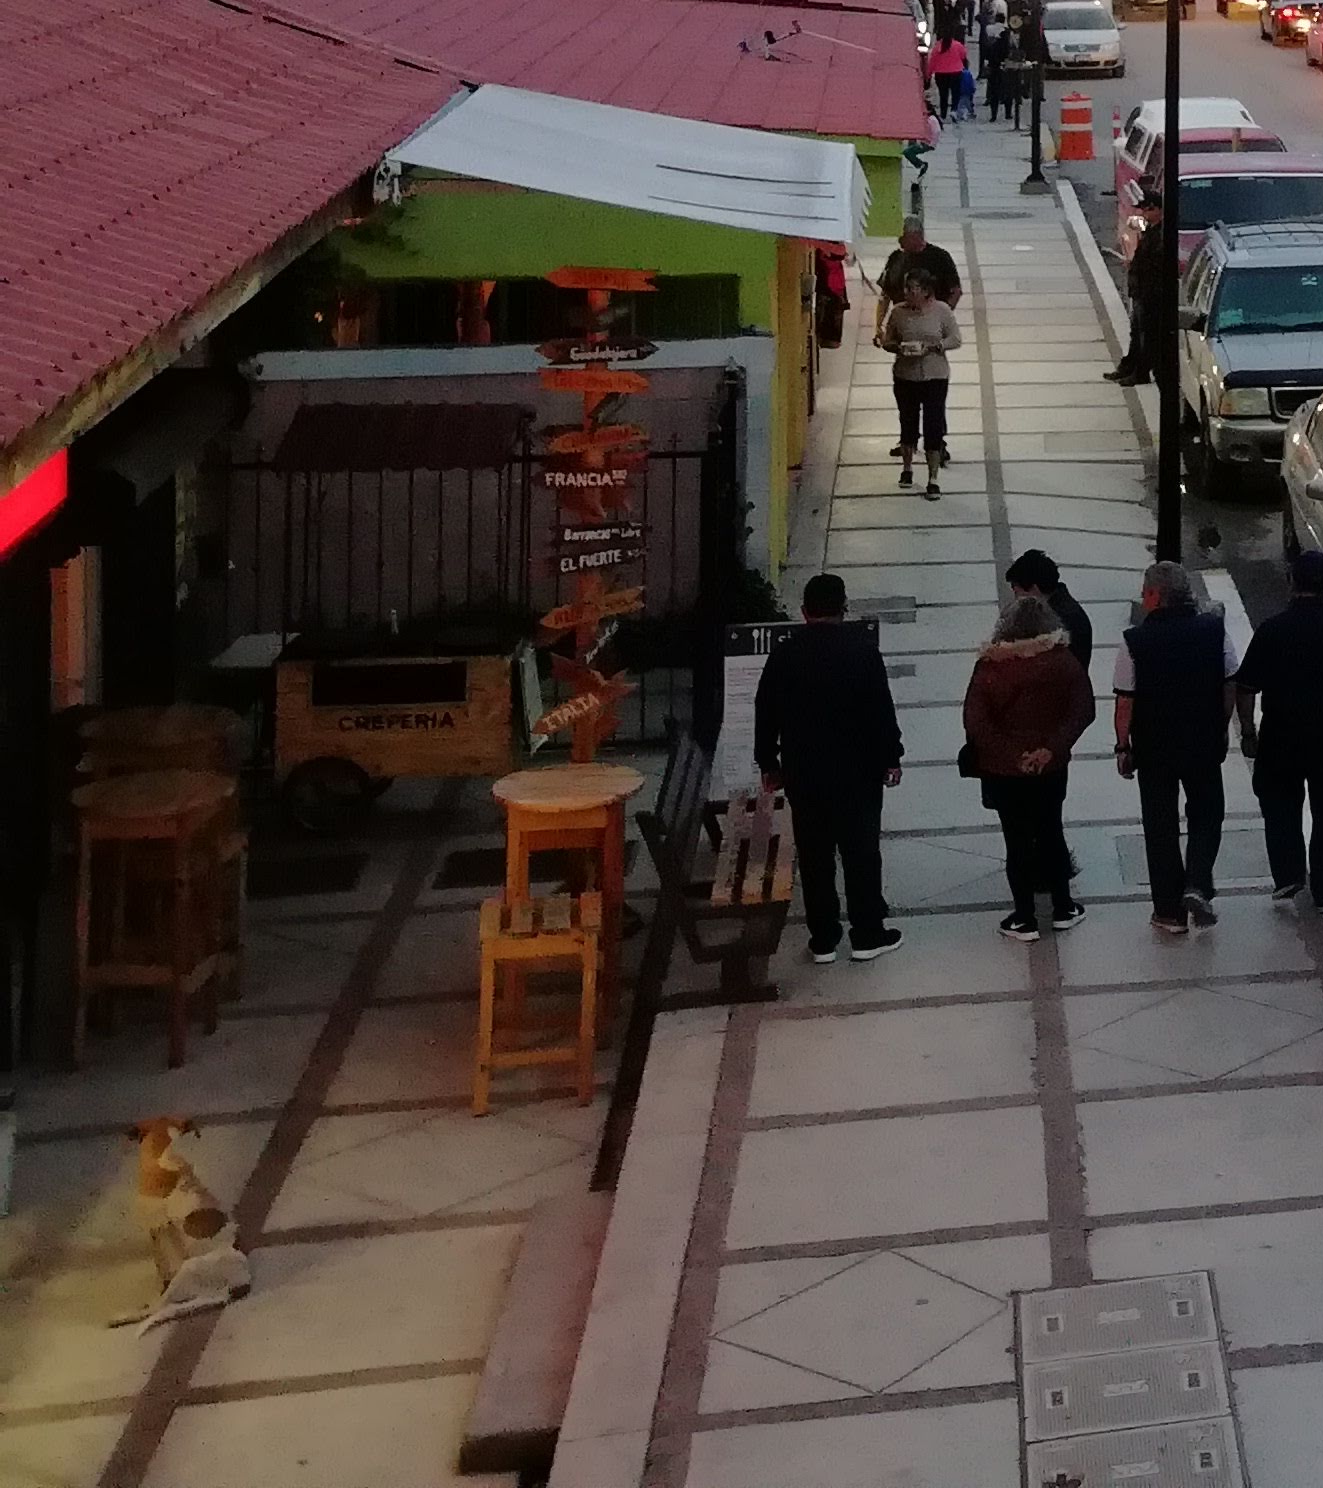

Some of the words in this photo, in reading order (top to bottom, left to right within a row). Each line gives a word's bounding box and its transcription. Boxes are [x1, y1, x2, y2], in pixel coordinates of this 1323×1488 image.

[544, 471, 614, 488] FRANCIA
[559, 556, 578, 573] EL
[578, 548, 623, 570] FUERTE
[542, 692, 600, 731] ITALIA
